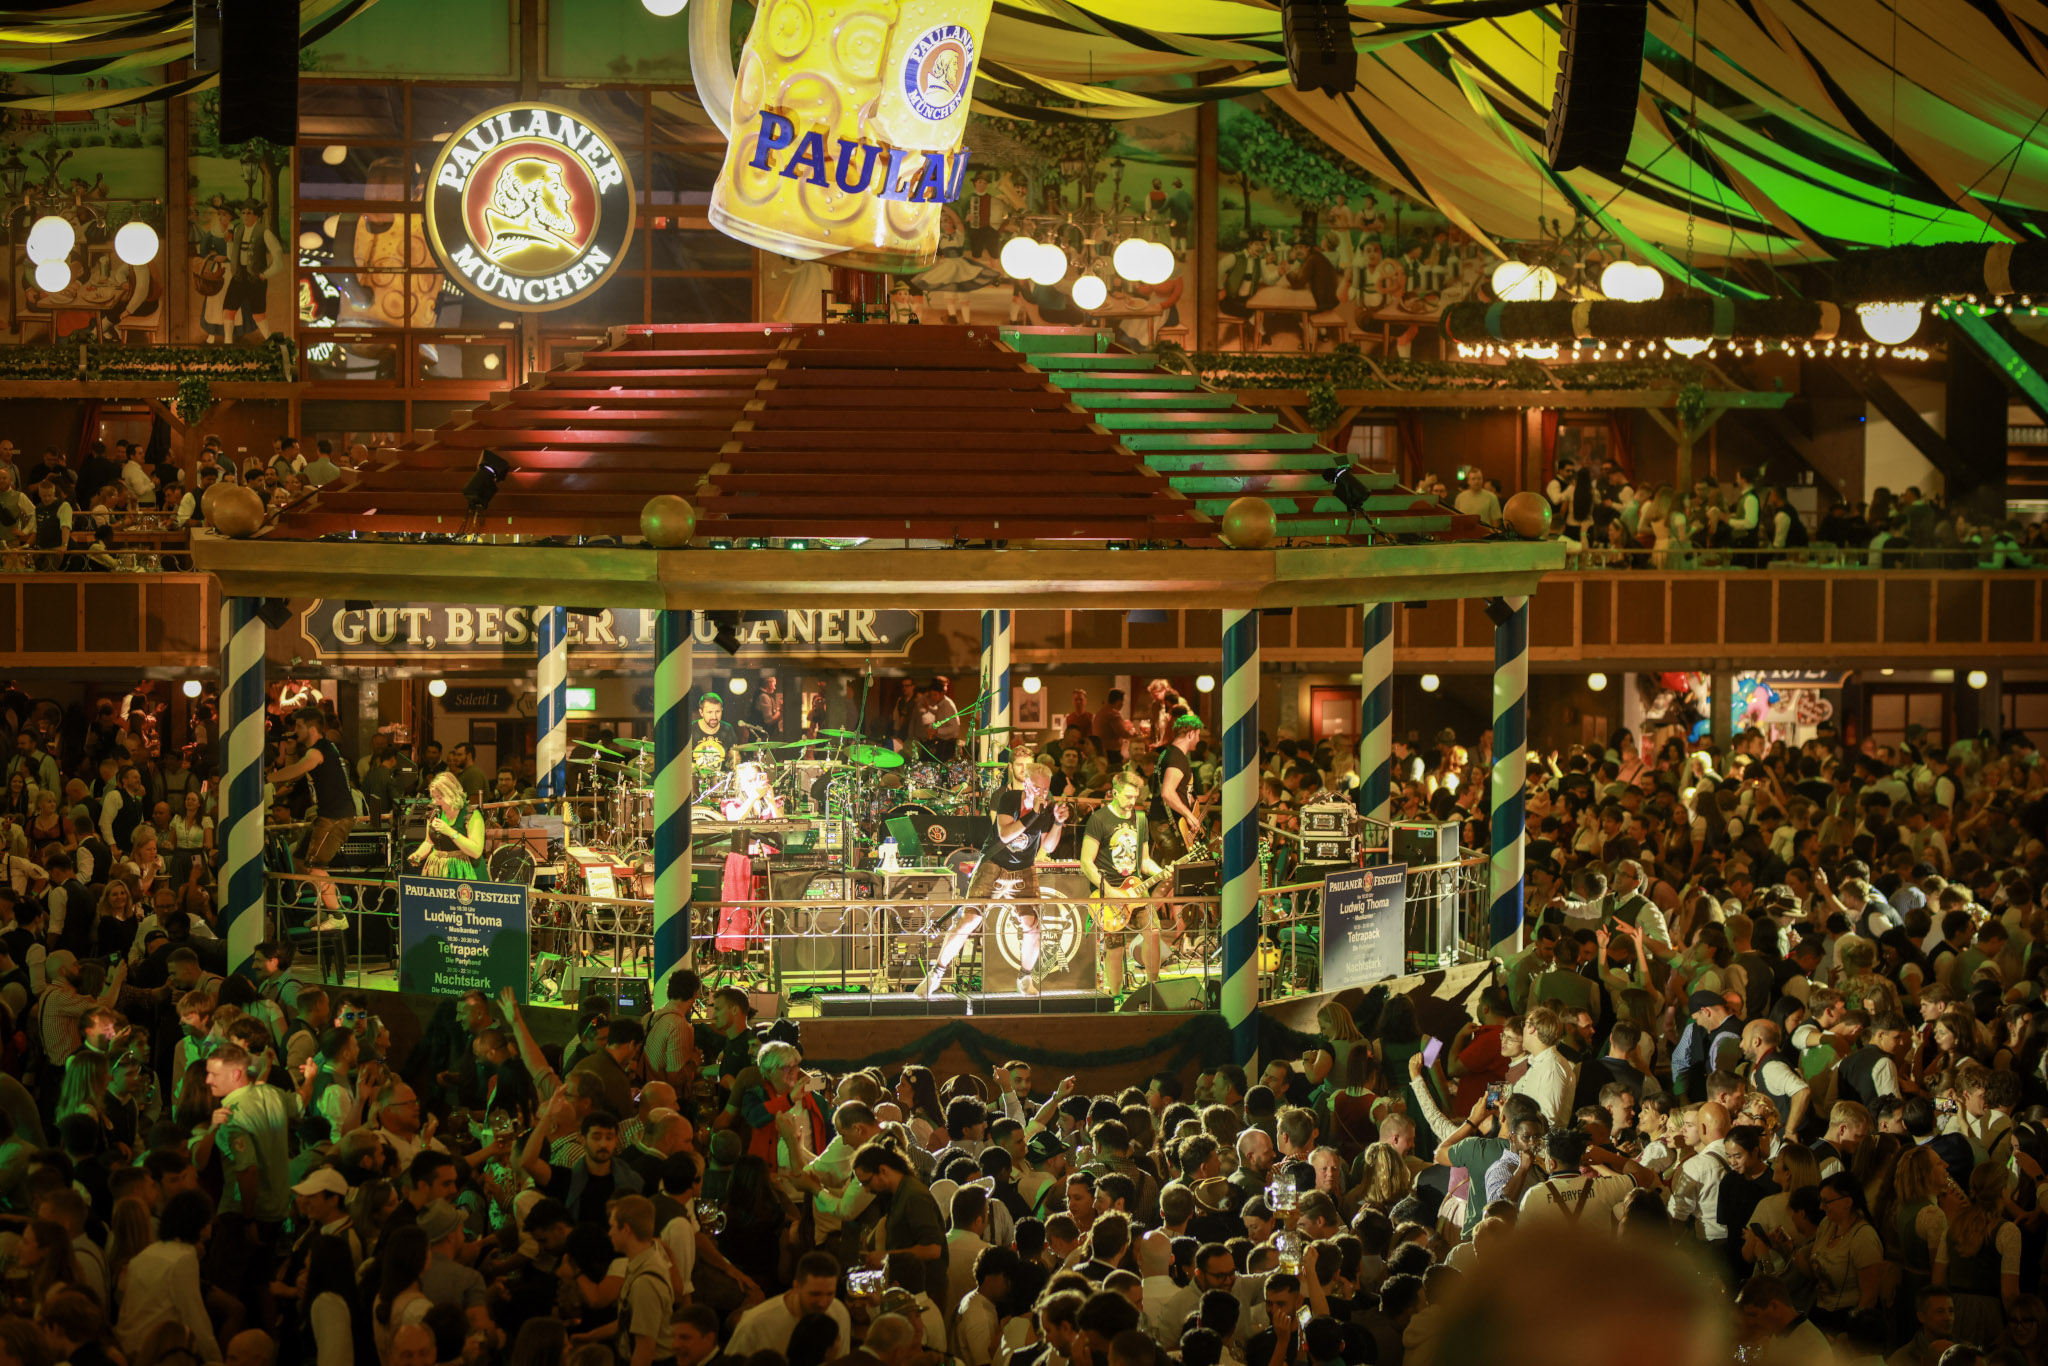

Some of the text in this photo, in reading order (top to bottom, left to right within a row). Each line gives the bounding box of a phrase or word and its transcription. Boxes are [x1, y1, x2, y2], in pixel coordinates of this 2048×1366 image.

[910, 25, 974, 67] PAULANER
[907, 88, 962, 120] MÜNCHEN
[438, 110, 623, 194] PAULANER
[451, 244, 612, 302] MÜNCHEN
[332, 607, 436, 648] GUT,
[444, 606, 628, 648] BESER,
[1329, 878, 1363, 892] PAULANER
[1373, 872, 1403, 887] FESTZELT
[404, 884, 457, 899] PAULANER
[474, 890, 521, 905] FESTZELT
[1340, 898, 1390, 915] Ludwig Thoma
[424, 909, 503, 928] Ludwig Thoma
[1347, 927, 1380, 943] Tetrapack
[438, 941, 489, 958] Tetrapack
[434, 972, 491, 988] Nachtstark
